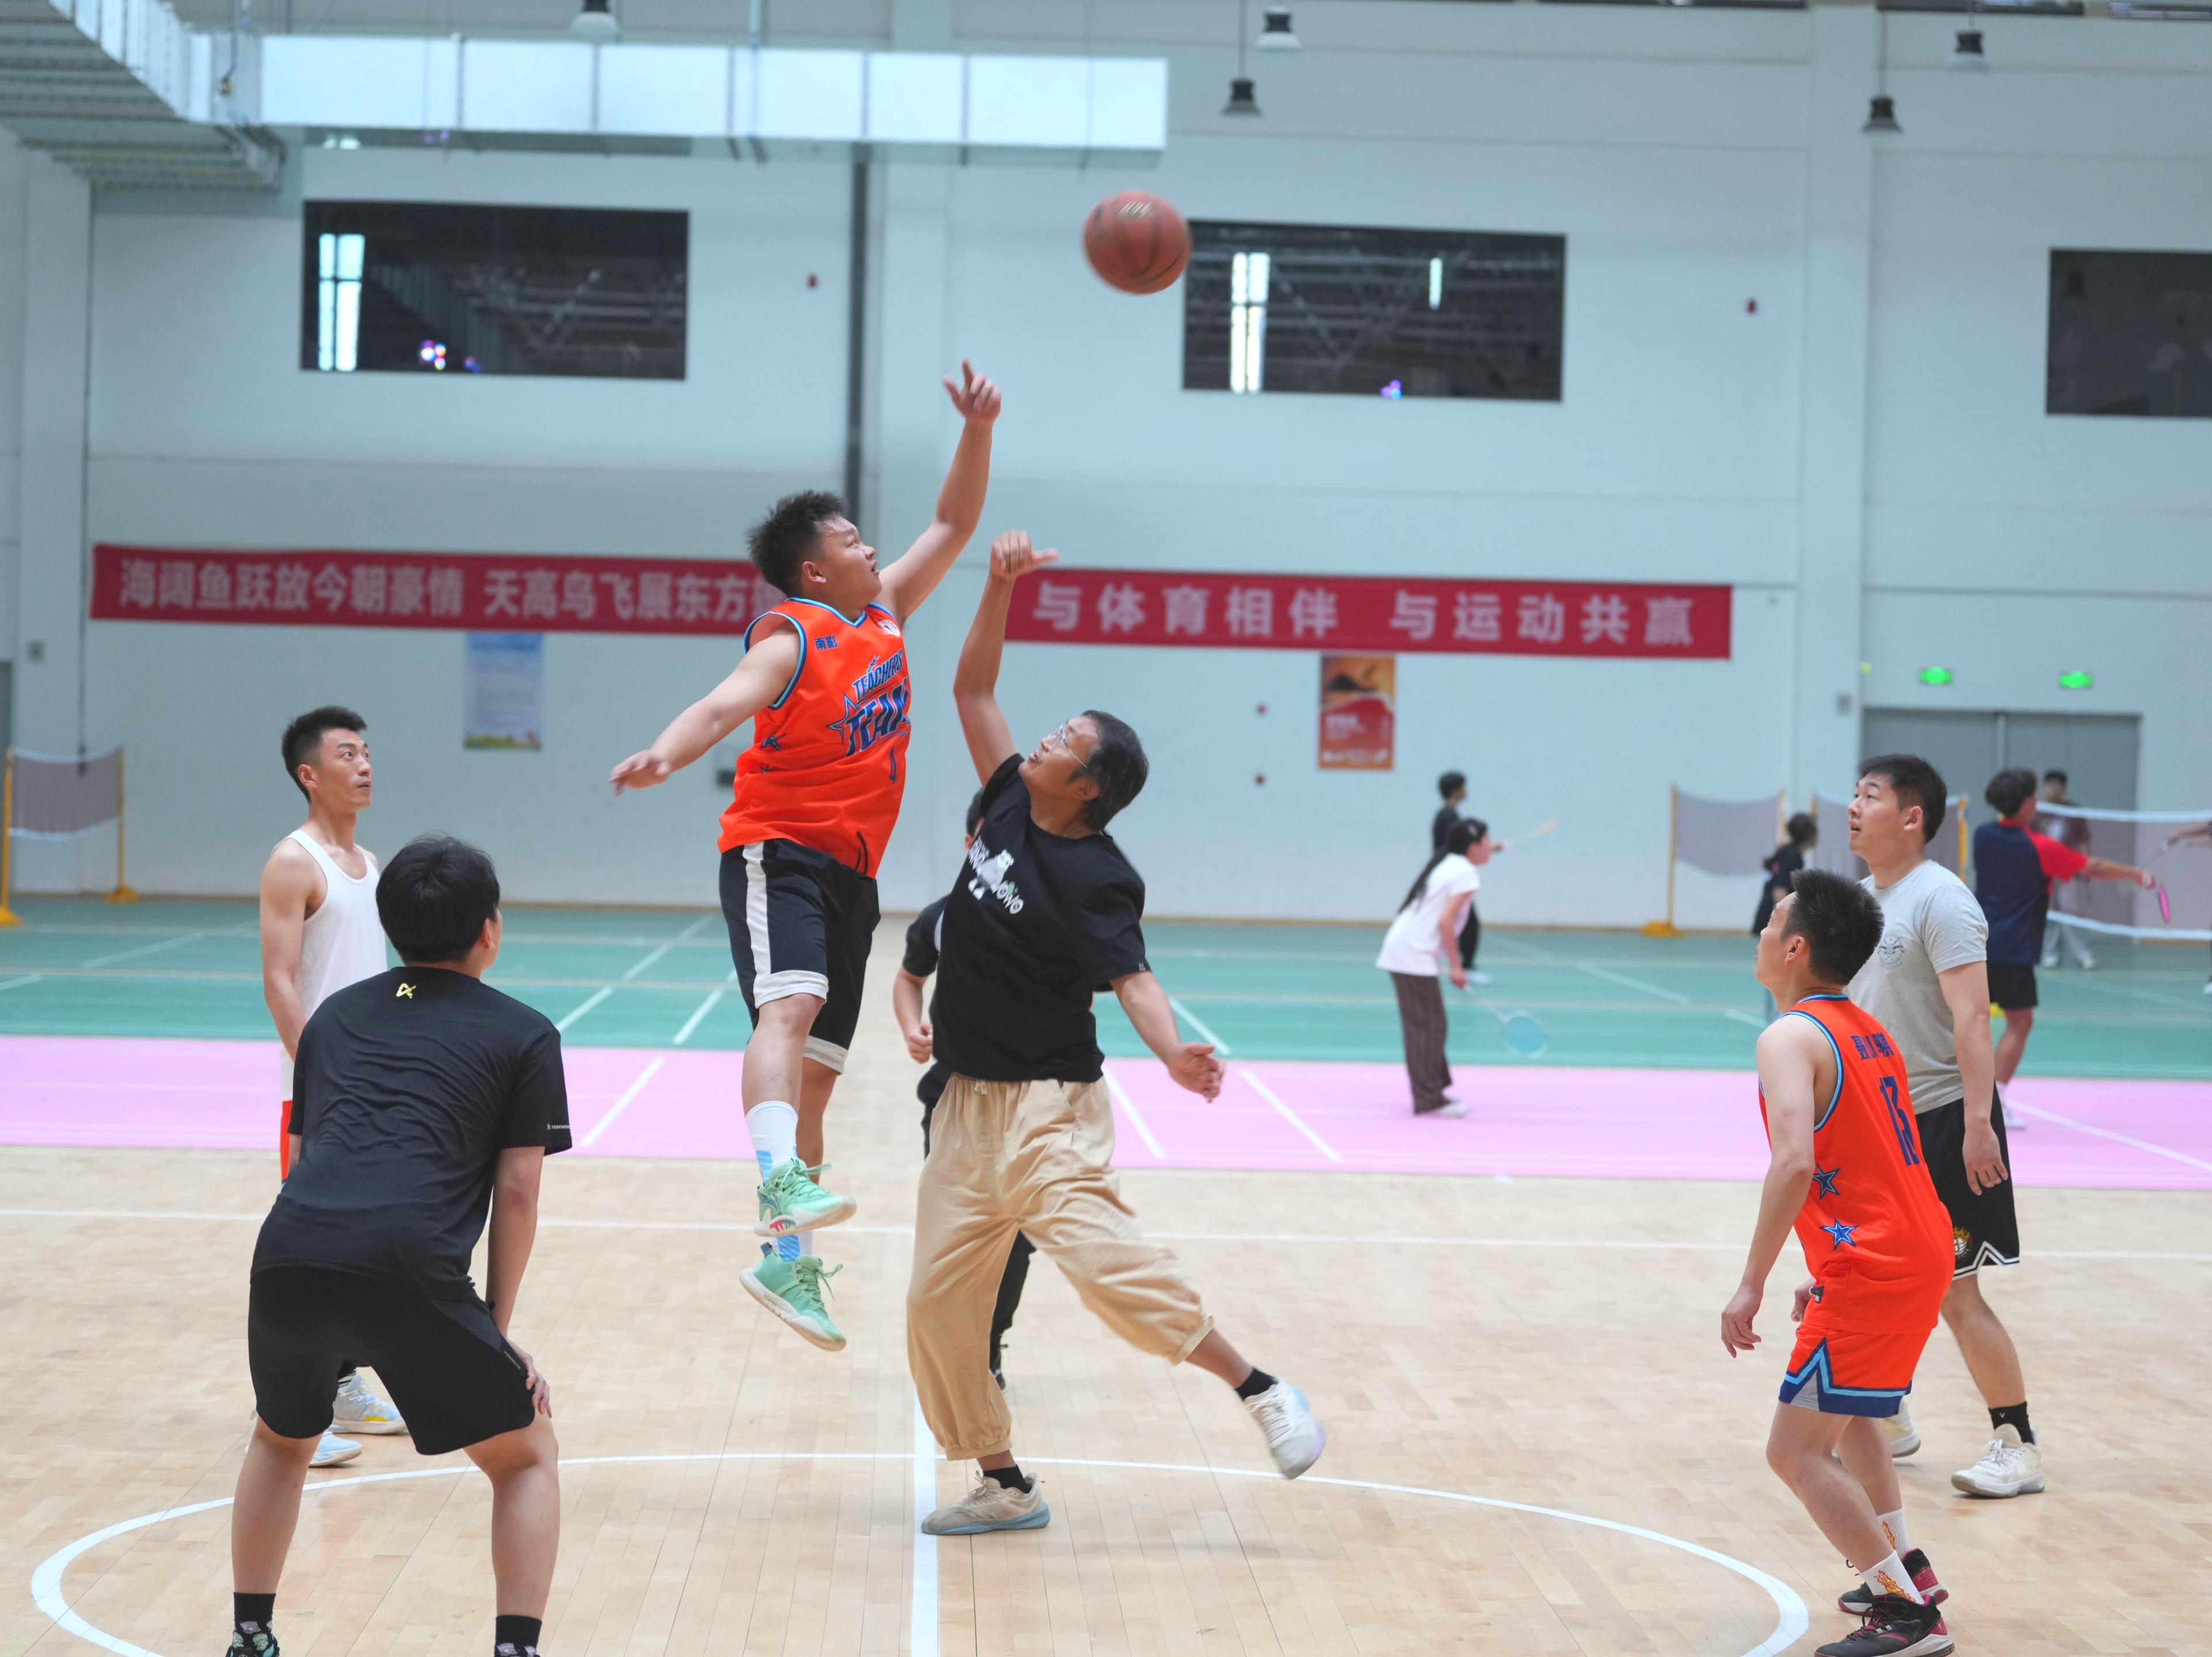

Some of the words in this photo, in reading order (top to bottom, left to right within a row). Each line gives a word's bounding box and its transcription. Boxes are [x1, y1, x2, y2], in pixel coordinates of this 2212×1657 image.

[120, 558, 464, 616] 海阔鱼跃放今朝豪情
[1033, 581, 1339, 639] 与体育相伴
[1389, 589, 1694, 646] 与运动共赢
[853, 649, 904, 701] TEACHERS
